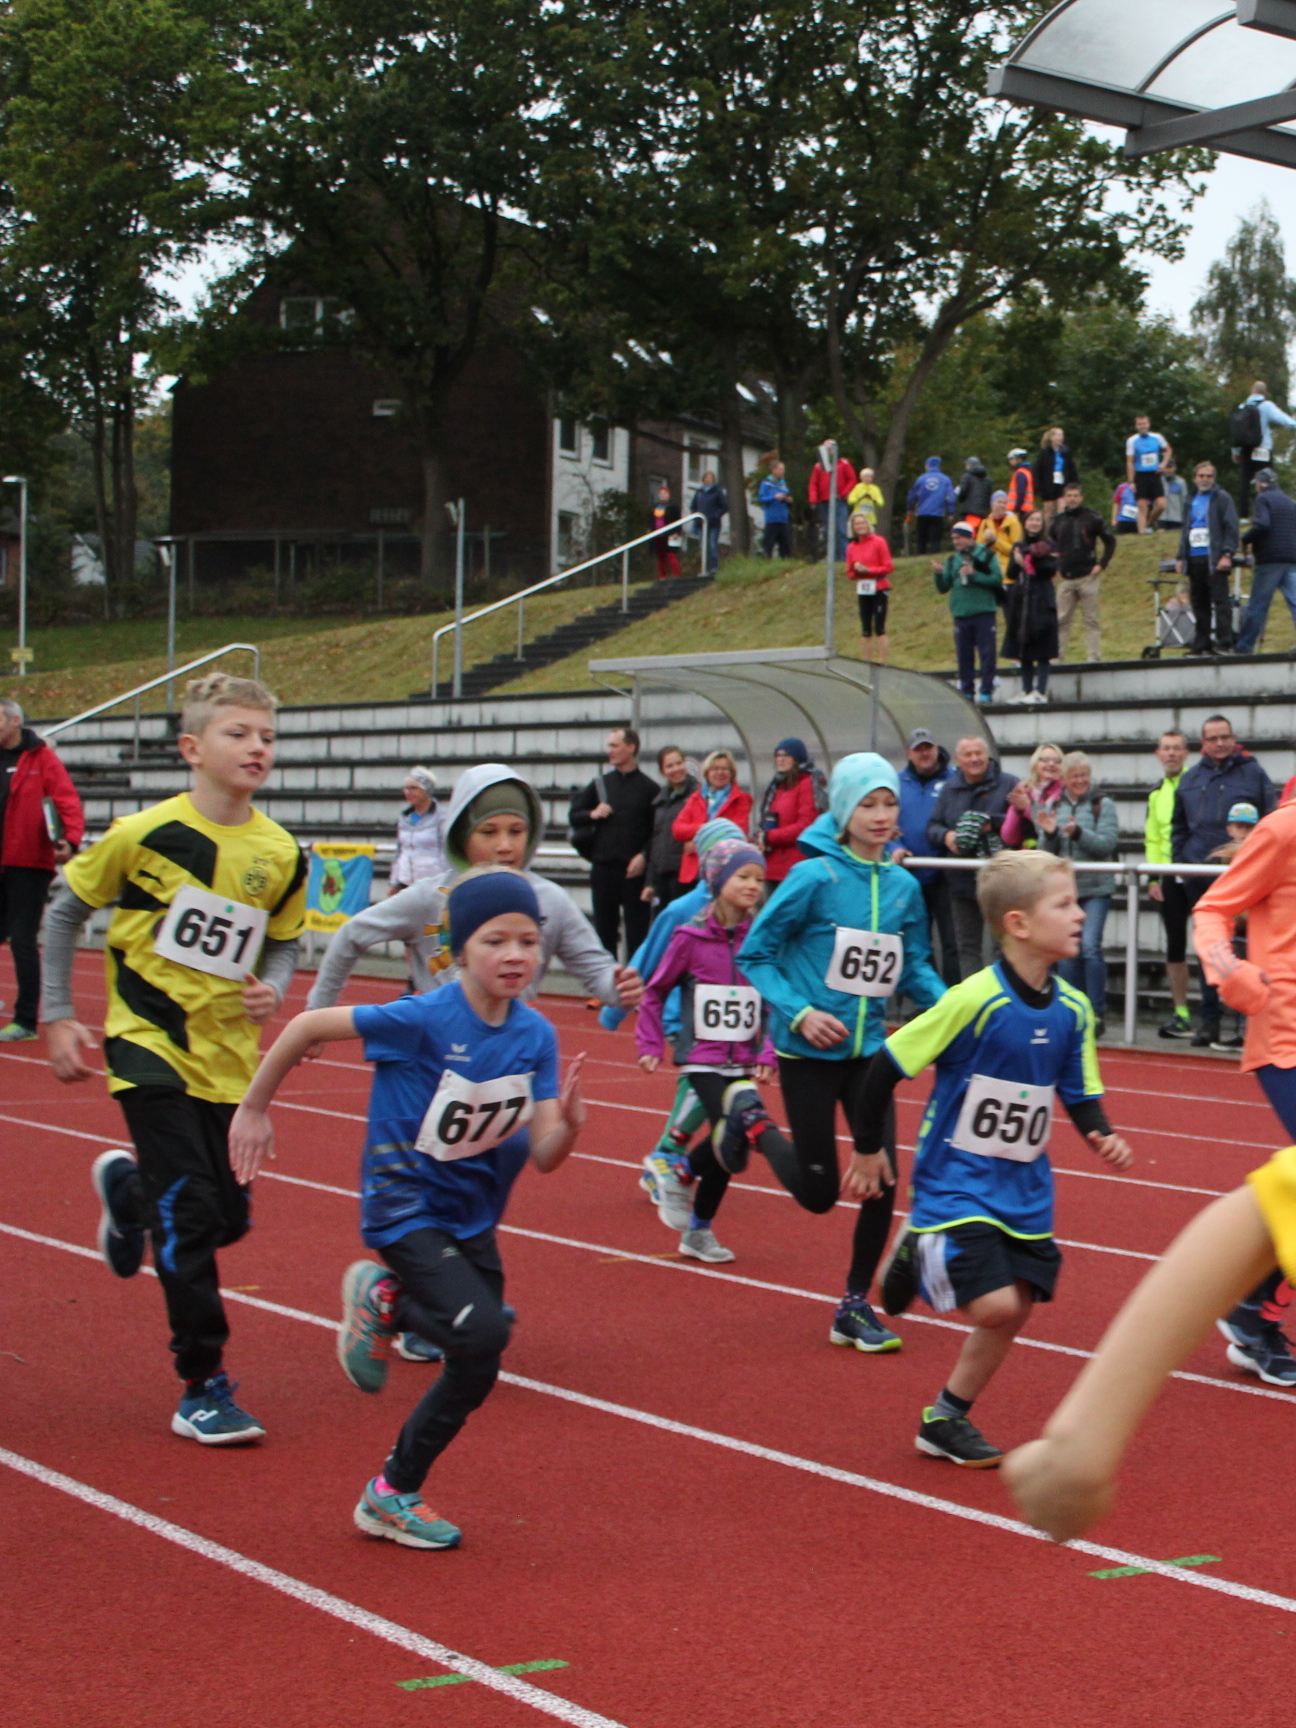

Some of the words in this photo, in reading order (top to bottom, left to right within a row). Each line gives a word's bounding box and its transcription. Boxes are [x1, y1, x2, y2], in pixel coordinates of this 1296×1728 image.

[174, 907, 254, 965] 651
[841, 945, 897, 985] 652
[704, 999, 756, 1030] 653
[437, 1096, 527, 1146] 677
[972, 1097, 1049, 1146] 650
